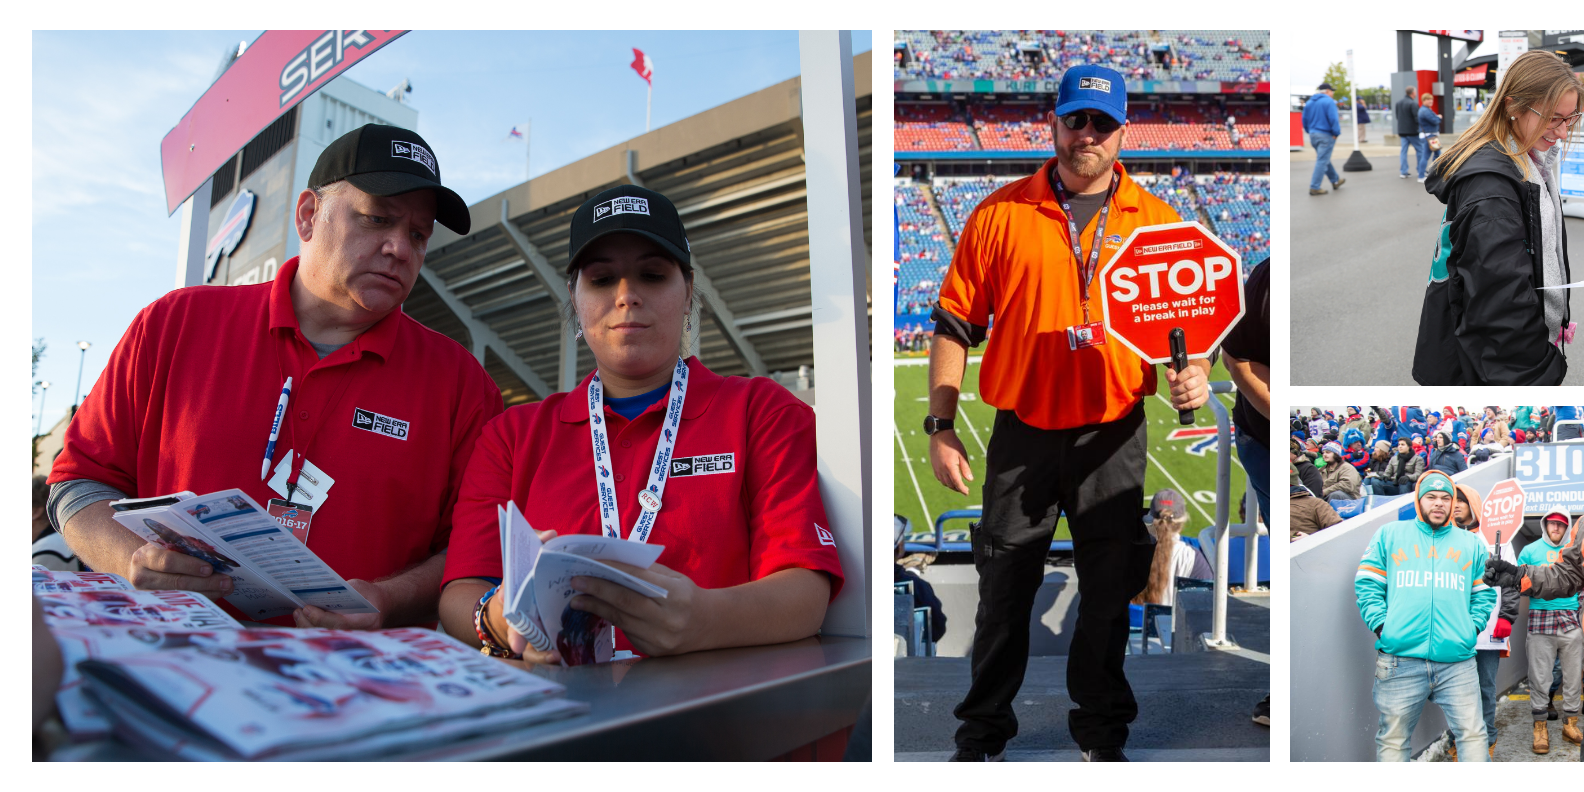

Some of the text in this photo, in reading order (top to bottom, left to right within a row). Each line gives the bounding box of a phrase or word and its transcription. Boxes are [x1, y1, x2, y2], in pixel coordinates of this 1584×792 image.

[279, 30, 394, 108] SER
[1091, 82, 1110, 92] FIELD
[613, 203, 648, 213] FIELD
[1143, 242, 1193, 253] NEW ERA FIELD
[1110, 255, 1233, 303] STOP
[1132, 295, 1216, 313] Please wait for
[1134, 305, 1216, 323] a break in play
[270, 403, 284, 435] BILLS
[668, 398, 677, 420] GUEST
[672, 395, 683, 428] SERVICES
[374, 421, 407, 438] FIELD
[376, 415, 408, 430] NEW ERA
[594, 429, 602, 461] SERVICES
[654, 450, 664, 475] GUEST
[657, 446, 671, 482] SERVICES
[694, 454, 733, 464] NEW ERA
[694, 461, 733, 473] FIELD
[600, 482, 610, 519] SERVICES
[607, 487, 615, 511] GUEST
[641, 492, 659, 508] RCW
[1484, 494, 1523, 518] STOP
[1568, 503, 1584, 511] your
[272, 515, 308, 531] 016-17
[636, 510, 649, 533] GUEST
[1391, 544, 1473, 572] MIAMI
[1396, 569, 1466, 592] DOLPHINS
